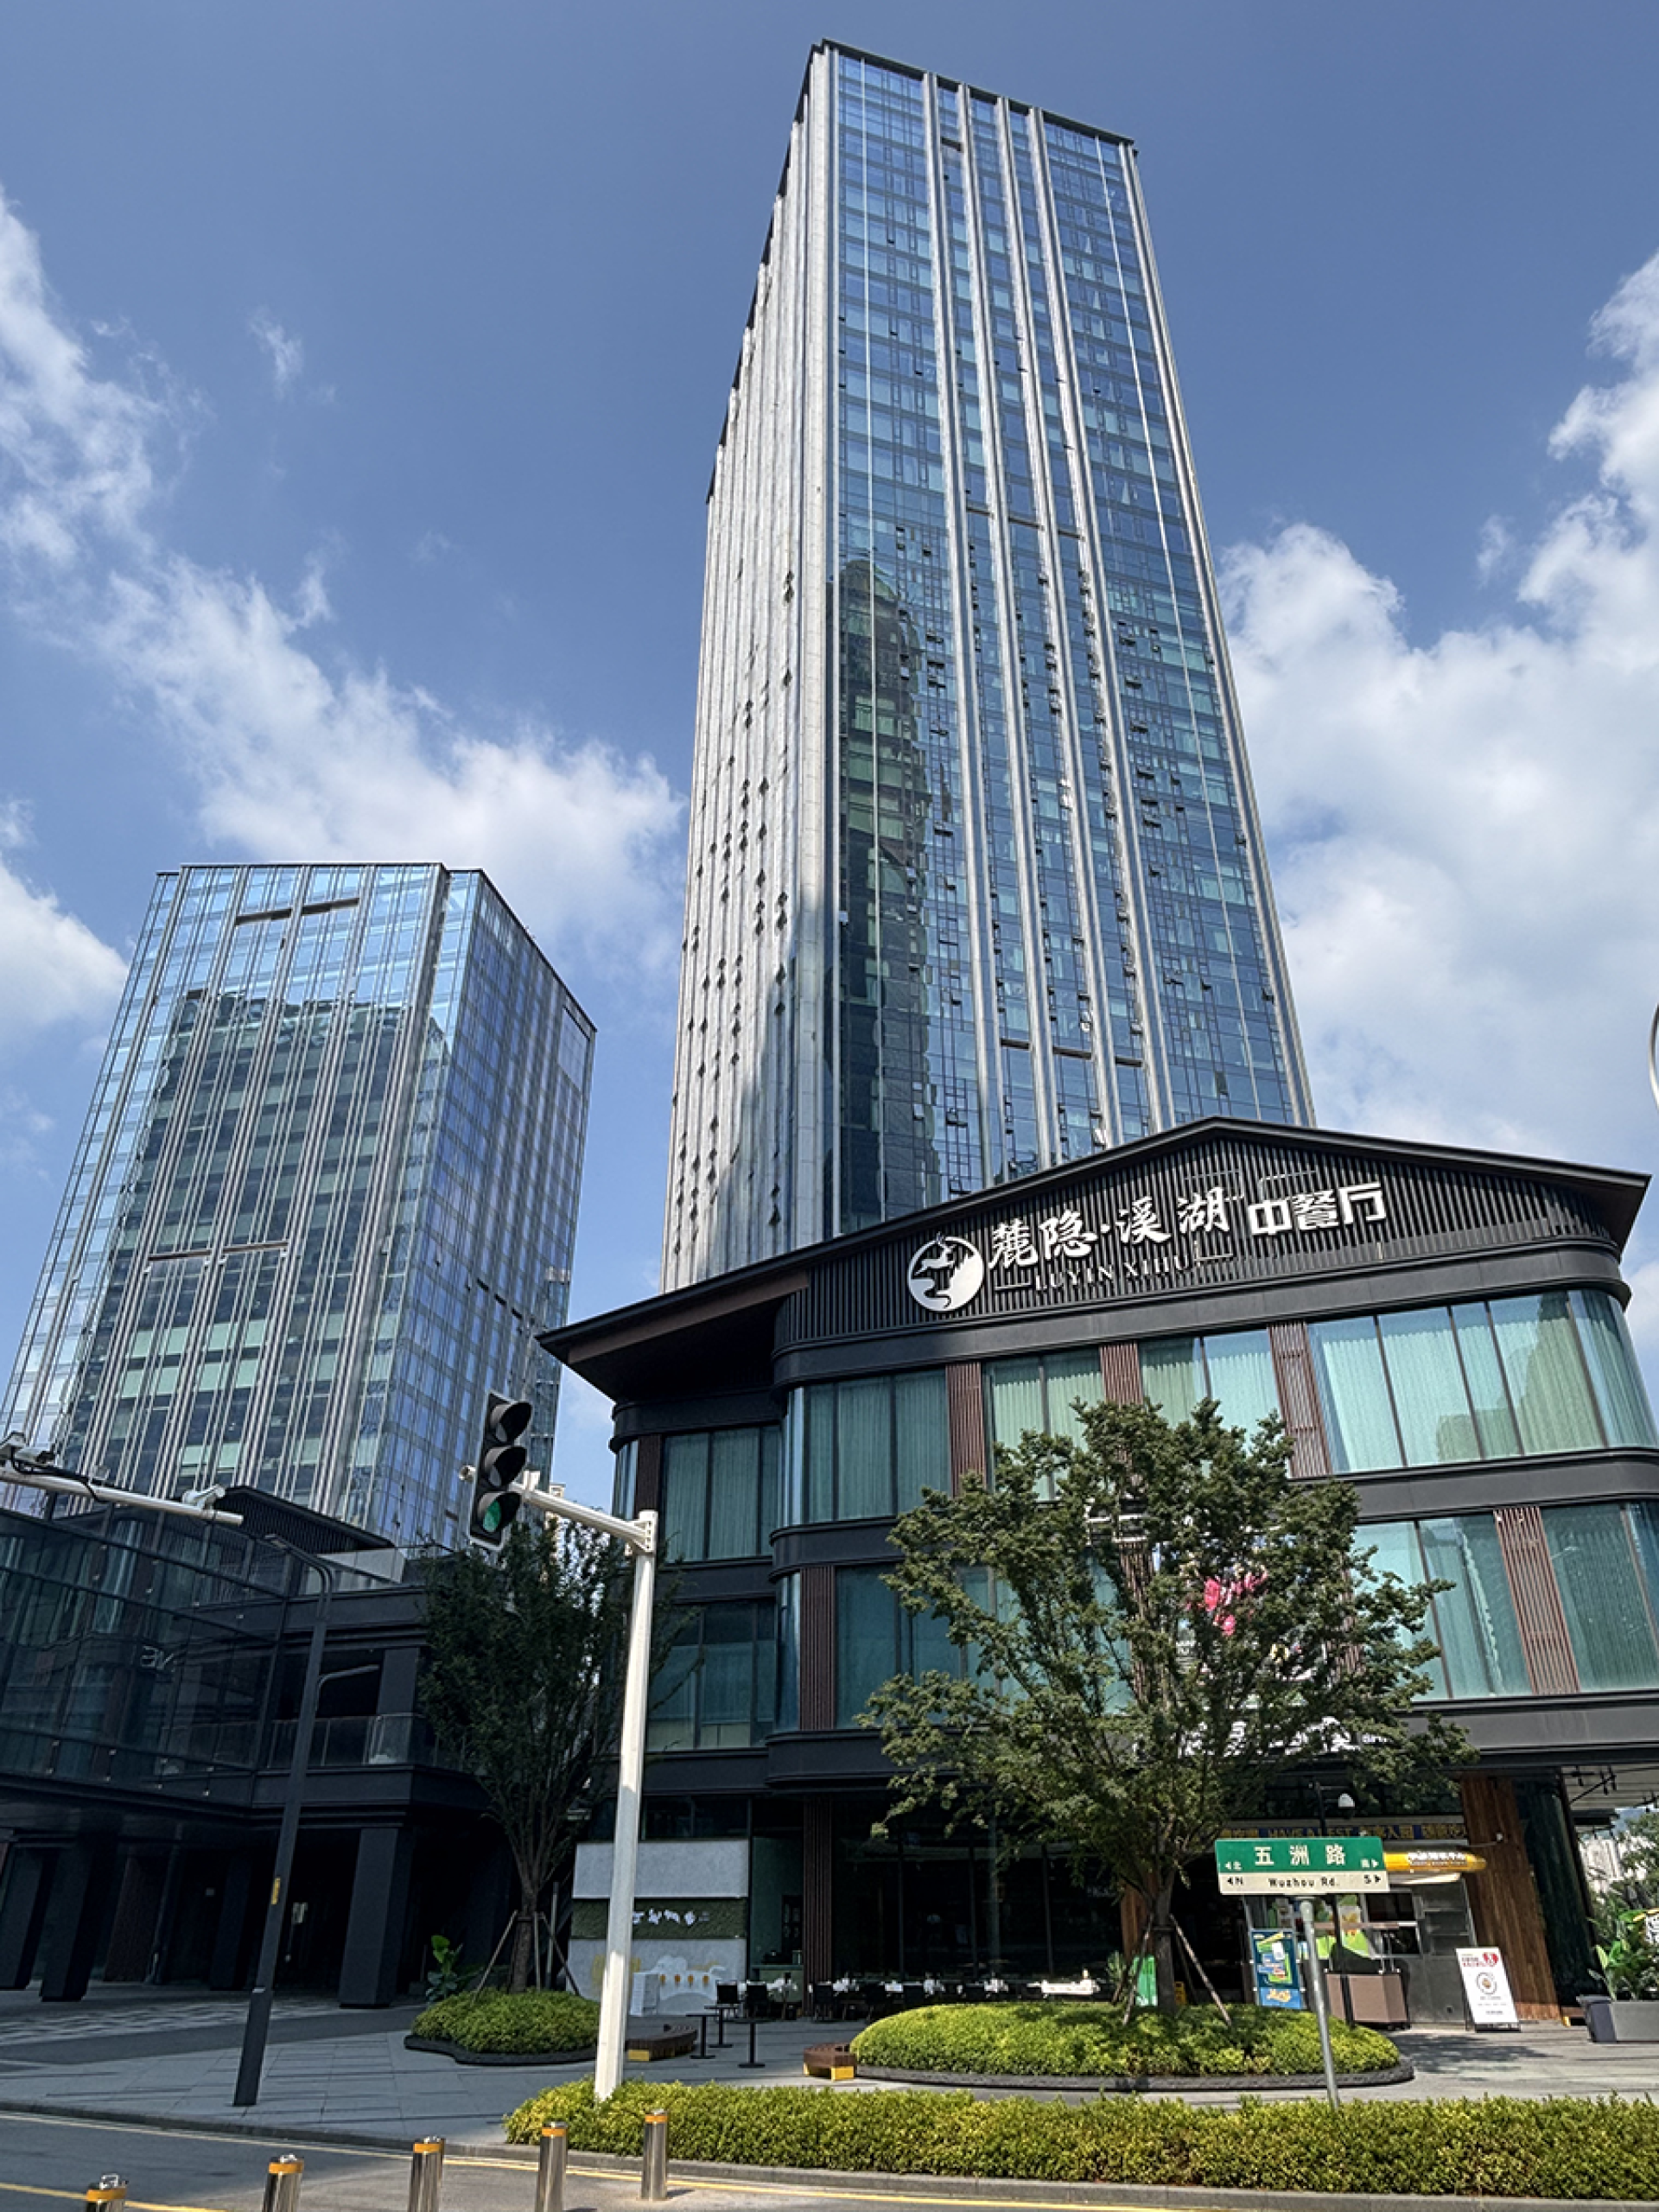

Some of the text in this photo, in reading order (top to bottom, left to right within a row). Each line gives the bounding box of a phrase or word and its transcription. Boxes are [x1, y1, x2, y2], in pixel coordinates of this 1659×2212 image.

[1247, 1181, 1386, 1236] 中餐厅
[1255, 1843, 1346, 1866] 五洲路
